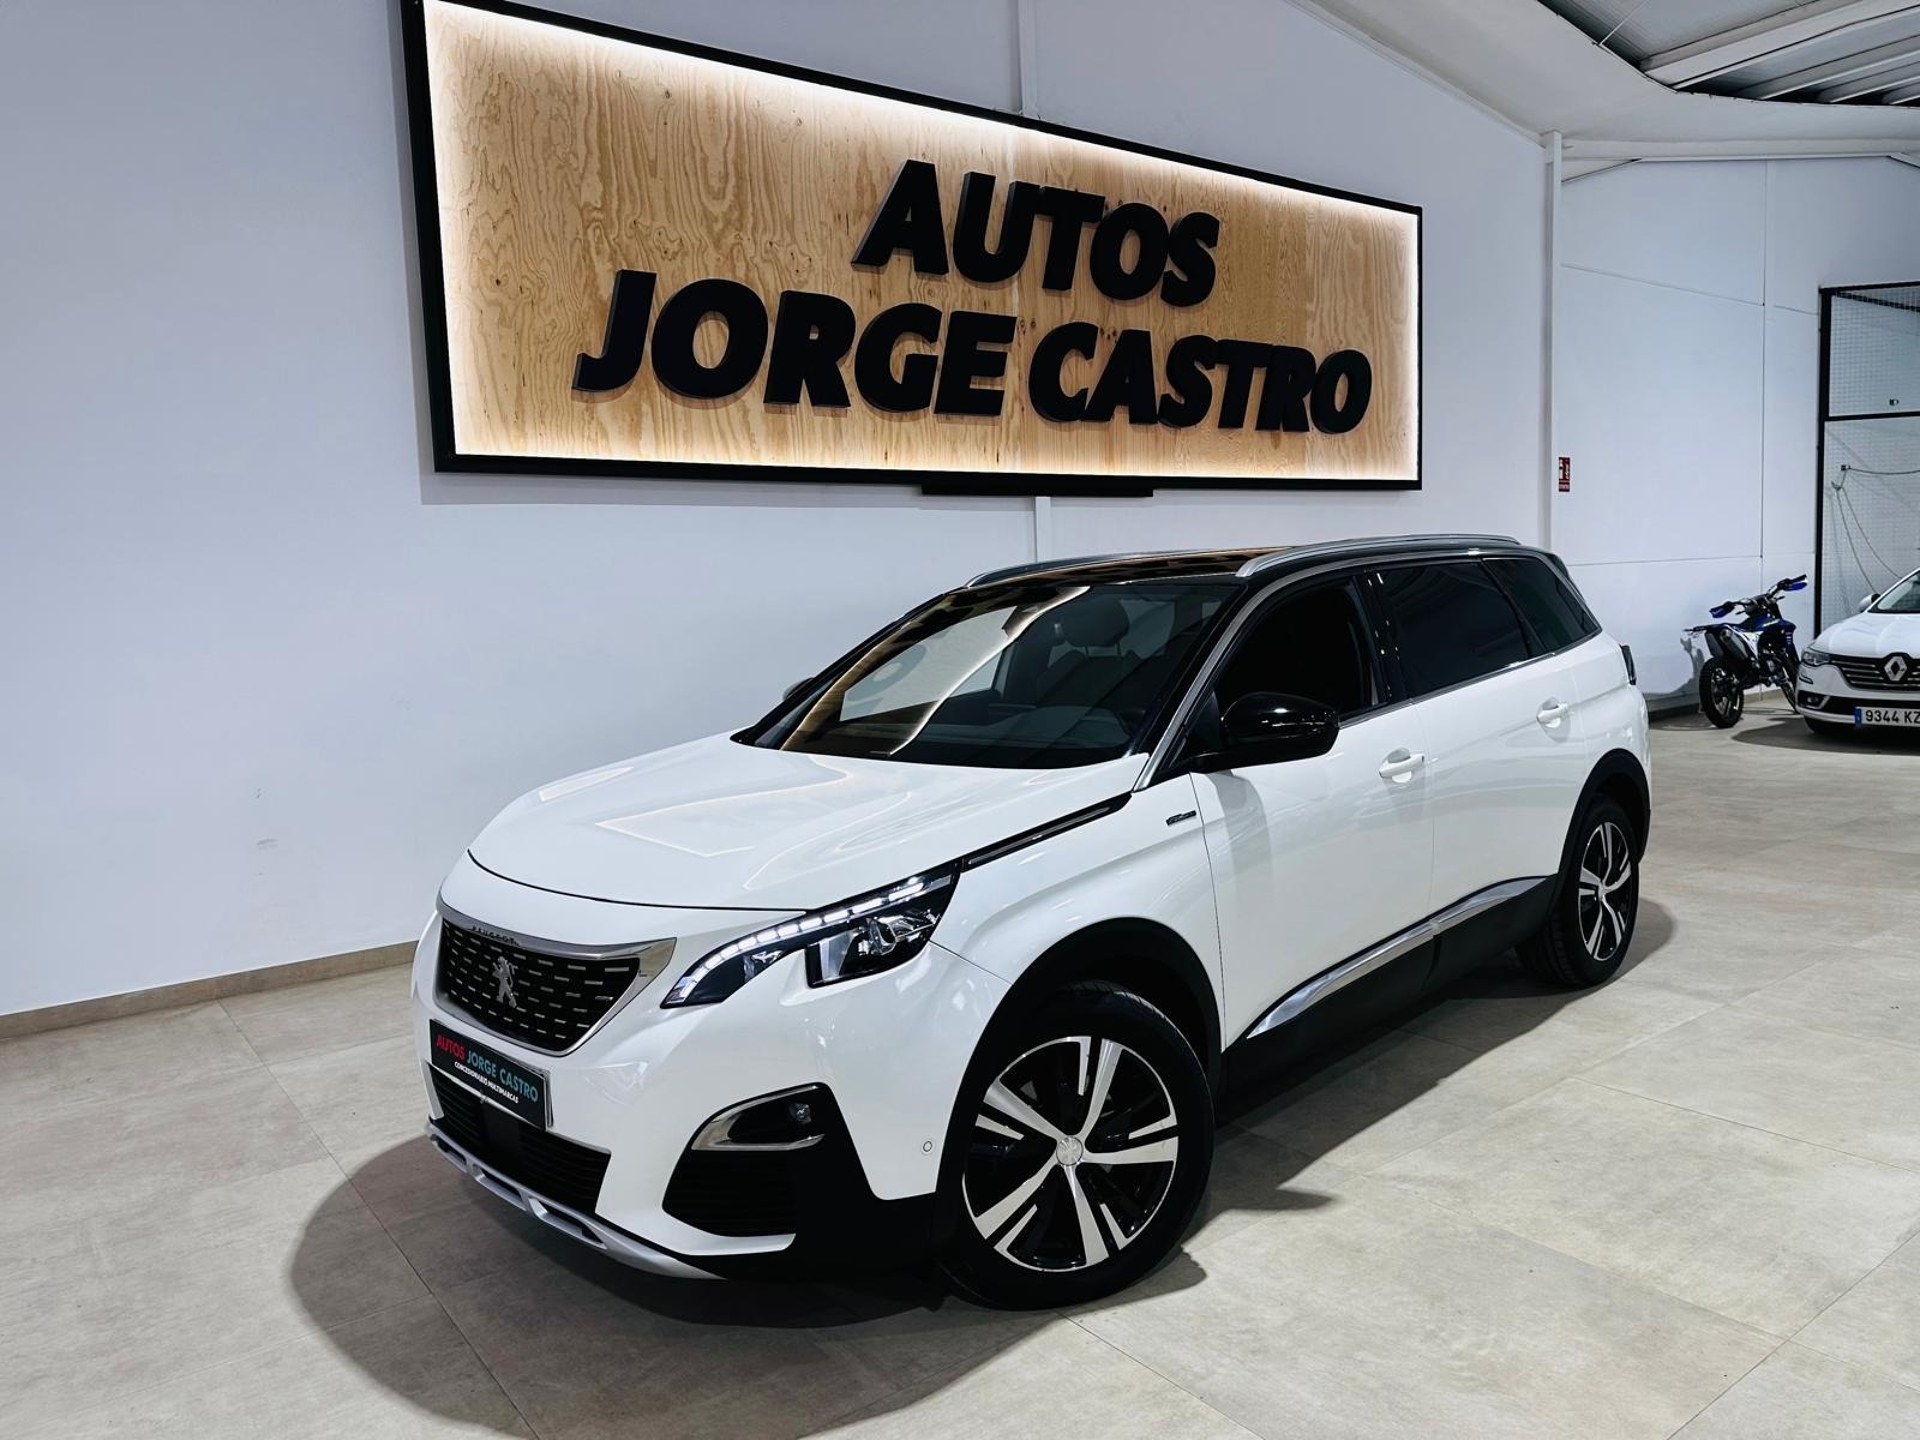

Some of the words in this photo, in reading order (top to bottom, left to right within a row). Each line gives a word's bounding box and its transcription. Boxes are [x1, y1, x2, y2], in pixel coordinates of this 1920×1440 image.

[852, 159, 1220, 307] AUTOS
[571, 268, 1017, 416] JORGE
[1028, 321, 1373, 435] CASTRO
[1865, 709, 1899, 723] 9344
[436, 1034, 465, 1060] AUTOS
[467, 1050, 497, 1078] JORGE
[499, 1067, 539, 1103] CASTRO
